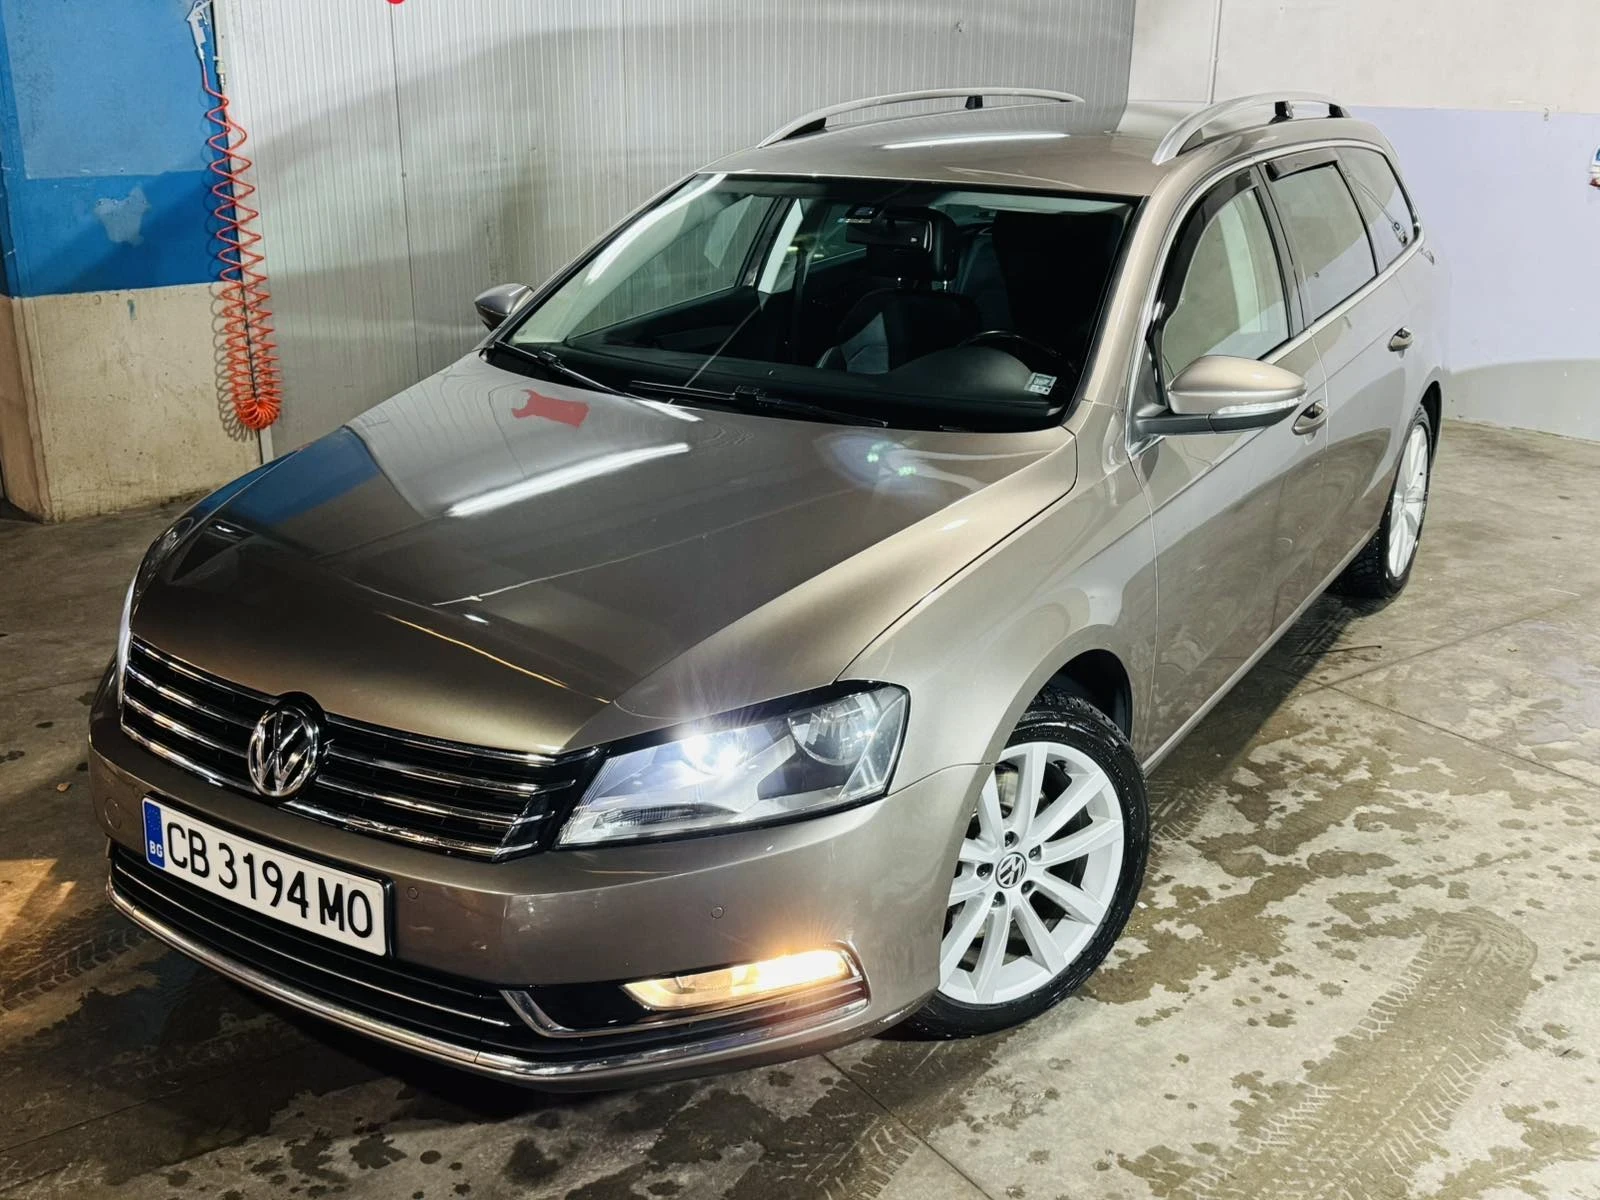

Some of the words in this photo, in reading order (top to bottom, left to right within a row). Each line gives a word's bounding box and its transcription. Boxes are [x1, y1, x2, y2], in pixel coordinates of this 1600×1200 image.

[149, 840, 164, 858] BG
[166, 822, 210, 878] CB
[218, 842, 309, 919] 3194
[318, 876, 373, 938] MO
